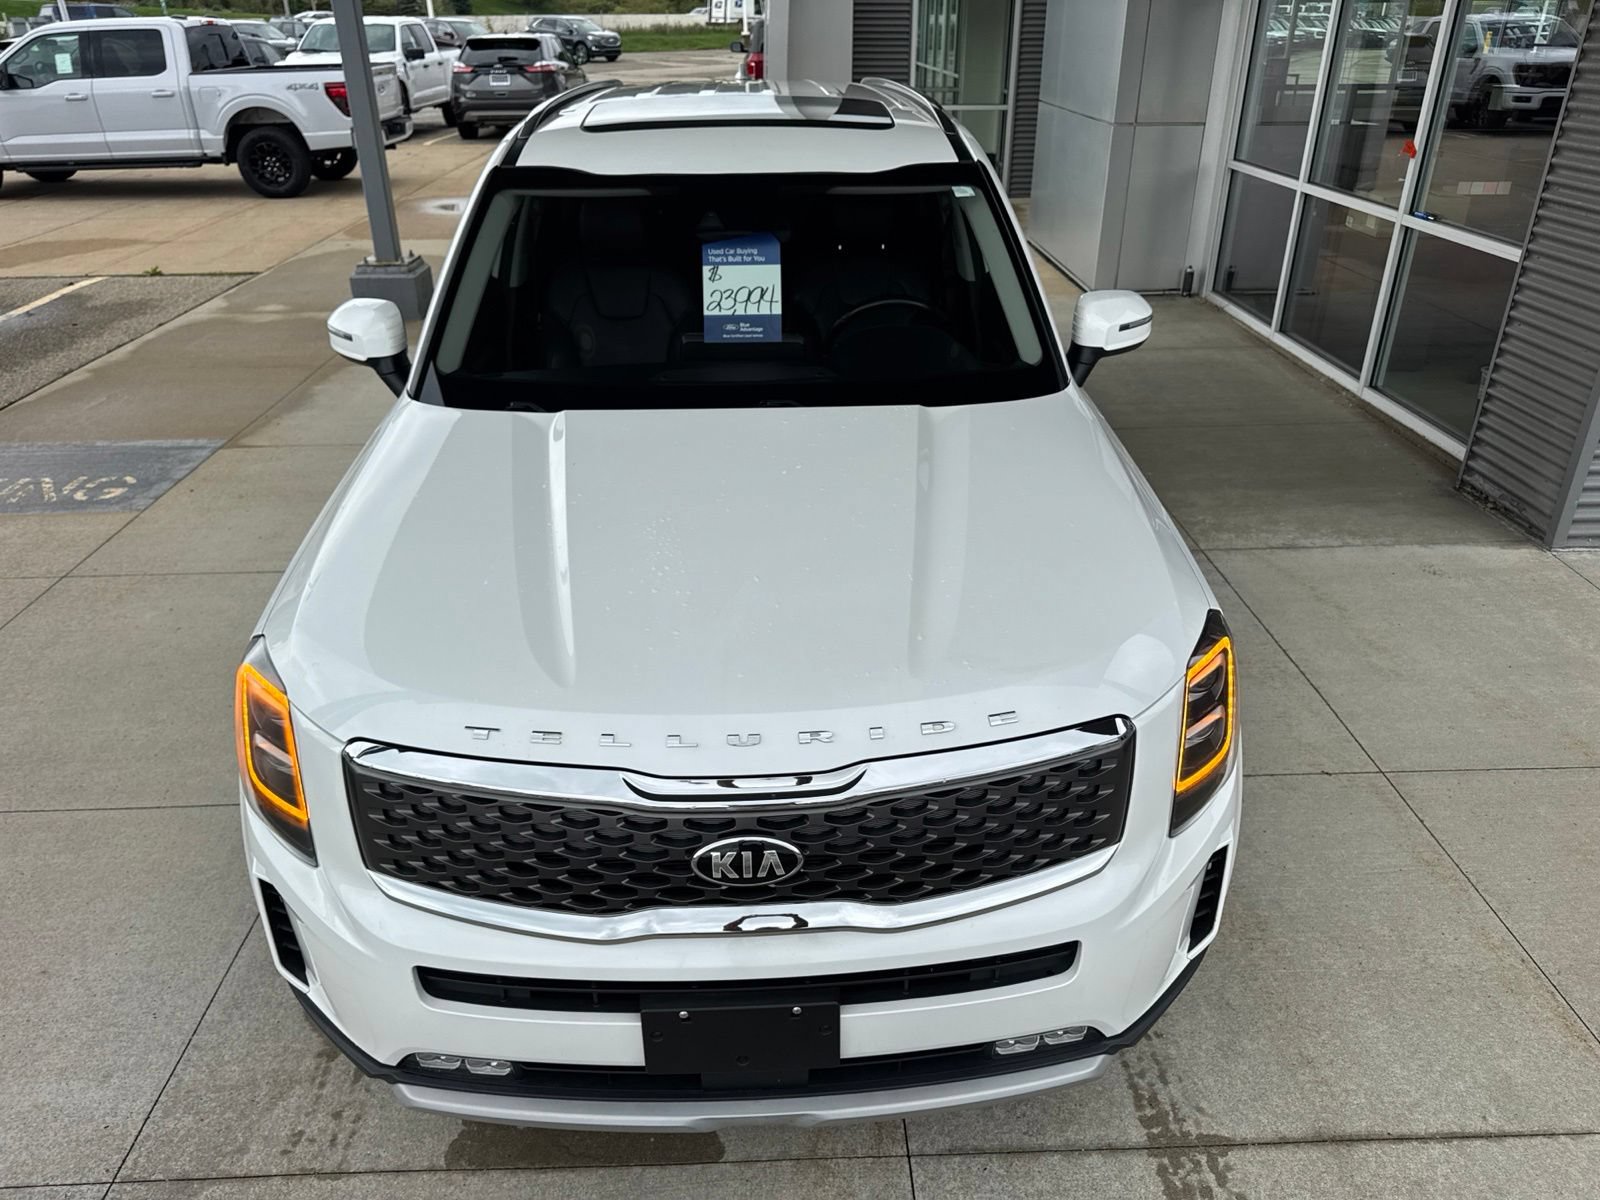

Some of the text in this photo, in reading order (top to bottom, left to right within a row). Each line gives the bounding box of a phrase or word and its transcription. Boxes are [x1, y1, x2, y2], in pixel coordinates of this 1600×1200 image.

[709, 255, 727, 263] That's
[728, 255, 742, 263] Built
[736, 247, 758, 256] Buying
[708, 265, 722, 283] $
[706, 284, 779, 316] 23,994
[464, 710, 1019, 748] TELLURIDE
[710, 850, 785, 878] KIA
